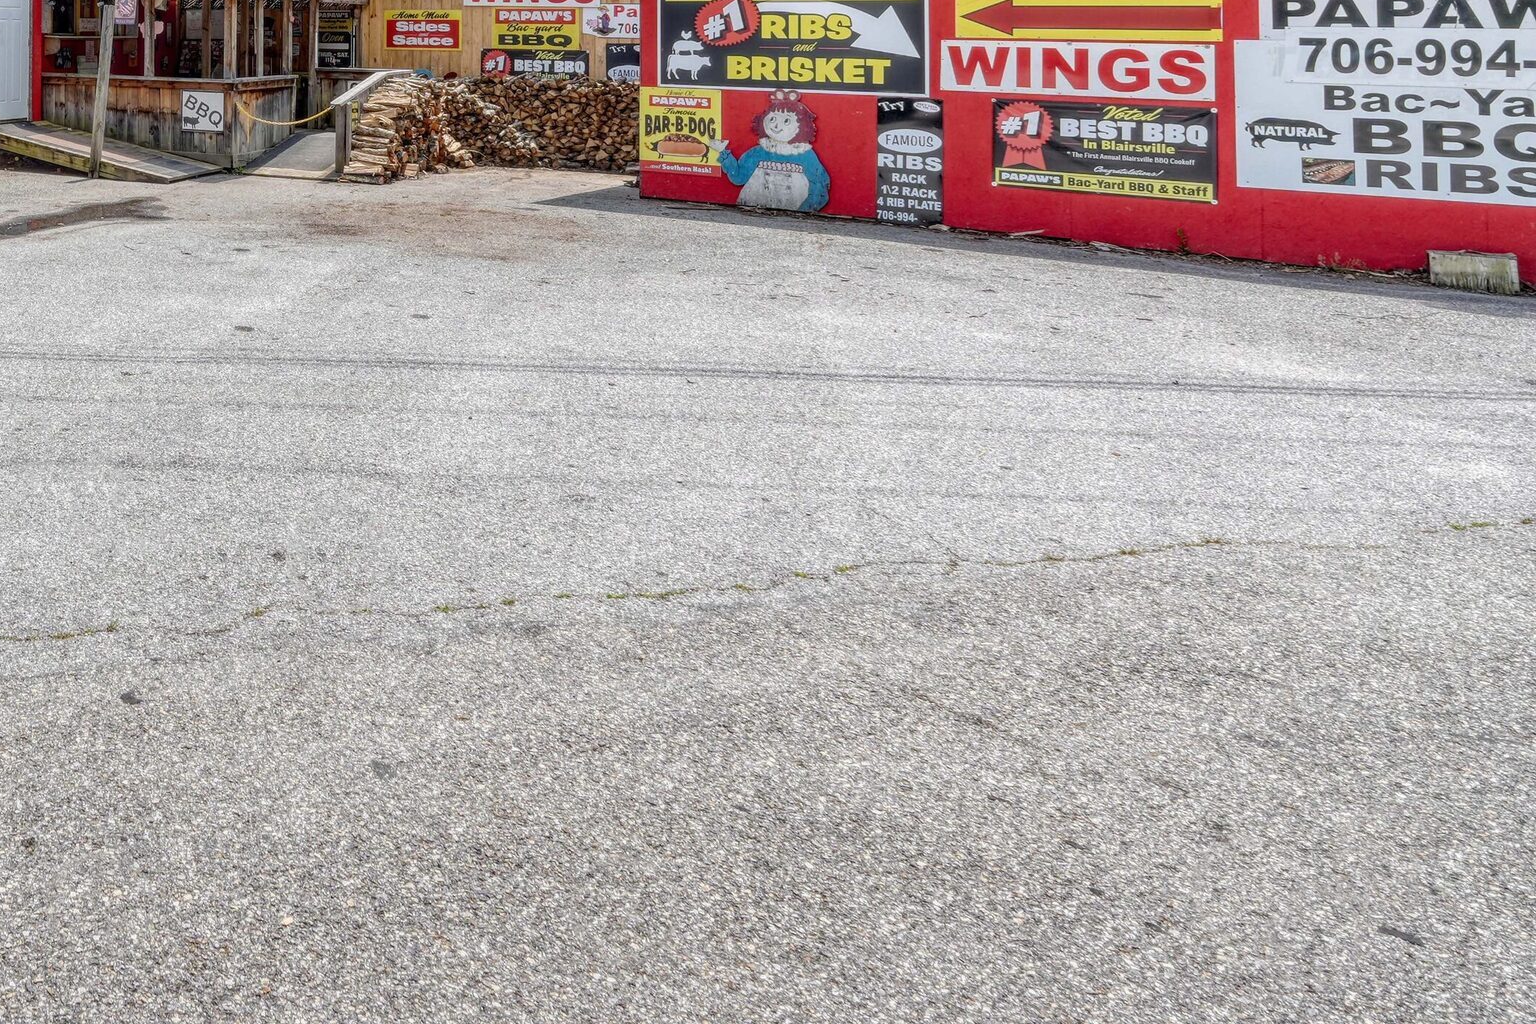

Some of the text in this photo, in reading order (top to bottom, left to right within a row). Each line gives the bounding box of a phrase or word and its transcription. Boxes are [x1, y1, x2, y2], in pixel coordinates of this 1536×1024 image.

[392, 11, 450, 19] Home Made
[499, 10, 573, 21] PAPAW'S
[703, 0, 745, 41] #1
[395, 21, 451, 32] Sides
[761, 13, 853, 40] RIBS
[392, 35, 454, 46] Sauce
[498, 34, 572, 48] BBQ
[792, 42, 817, 52] and
[535, 50, 565, 60] Voted
[609, 45, 627, 53] Try
[485, 55, 505, 71] #1
[514, 59, 586, 75] BEST BBQ
[726, 55, 891, 84] BRISKET
[947, 46, 1207, 94] WINGS
[652, 97, 709, 107] PAPAW'S
[878, 101, 904, 111] Try
[184, 94, 224, 128] BBQ
[1102, 105, 1164, 122] Voted
[1001, 111, 1041, 136] #1
[1060, 118, 1209, 147] BEST BBQ
[1254, 125, 1328, 138] NATURAL
[885, 134, 934, 148] FAMOUS
[1083, 139, 1176, 155] In Blairsville
[1352, 118, 1536, 163] BBQ
[877, 152, 942, 172] RIBS
[1100, 153, 1121, 161] Annual
[1122, 154, 1153, 163] Blairsville
[1154, 156, 1169, 164] BBQ
[1170, 157, 1195, 166] Cookoff
[892, 173, 927, 185] RACK
[1001, 172, 1208, 198] PAPAW'S Bac-Yard BBQ & Staff
[1366, 159, 1536, 198] RIBS
[902, 187, 937, 199] RACK
[877, 197, 942, 211] 4 RIB PLATE
